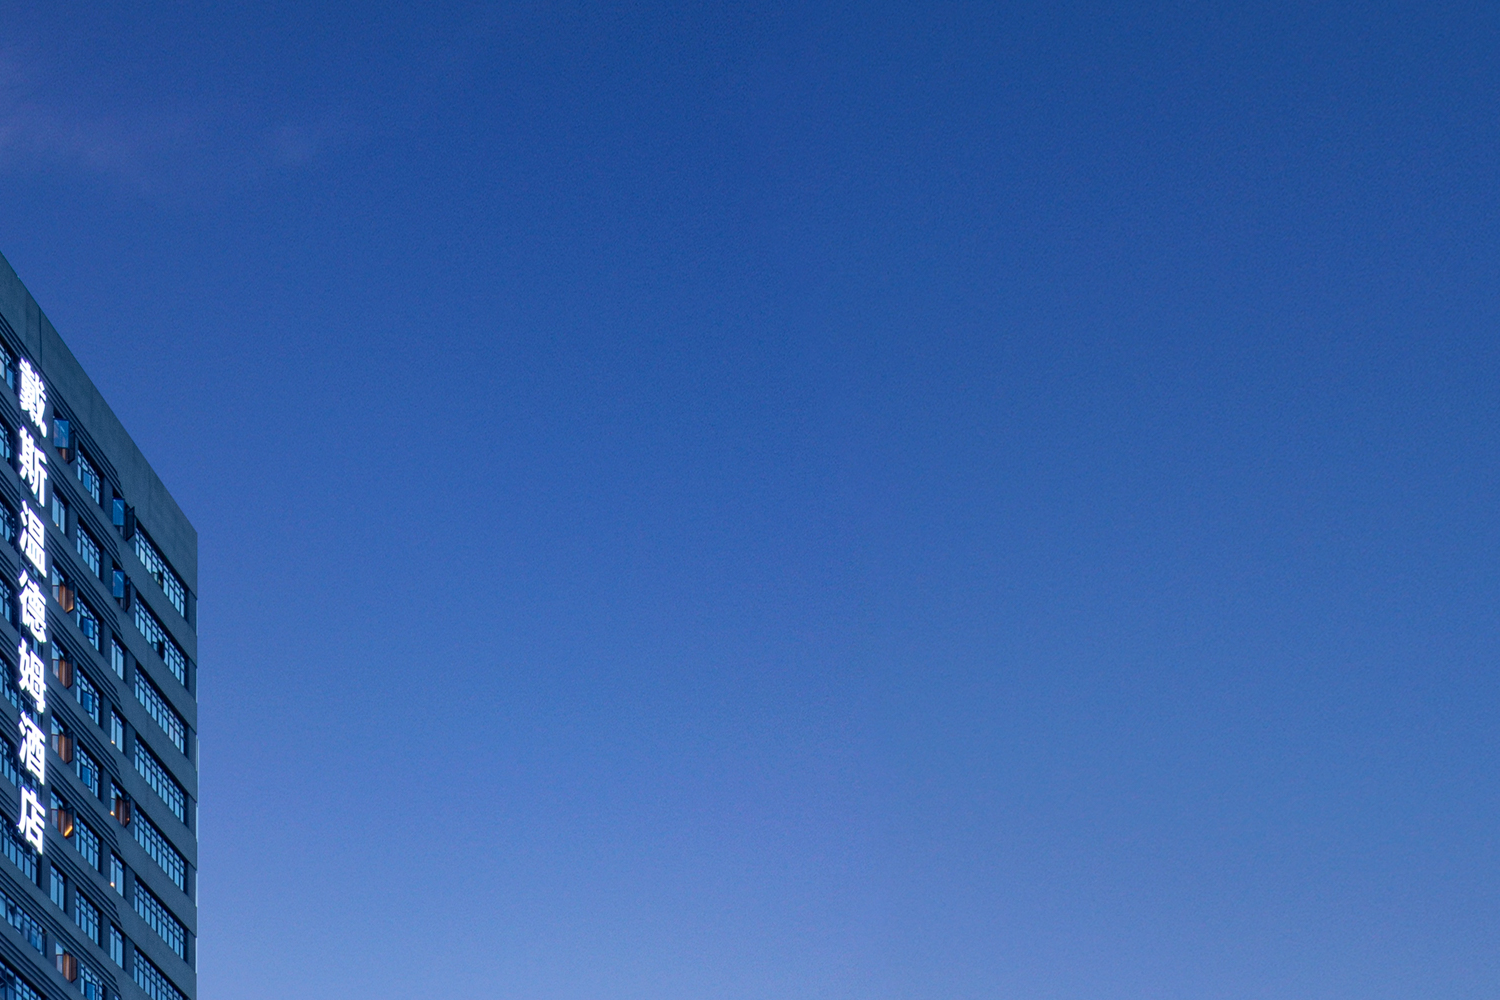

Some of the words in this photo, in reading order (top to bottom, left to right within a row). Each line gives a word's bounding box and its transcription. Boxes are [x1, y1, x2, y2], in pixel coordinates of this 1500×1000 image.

[17, 357, 48, 855] 戴斯温德姆酒店
